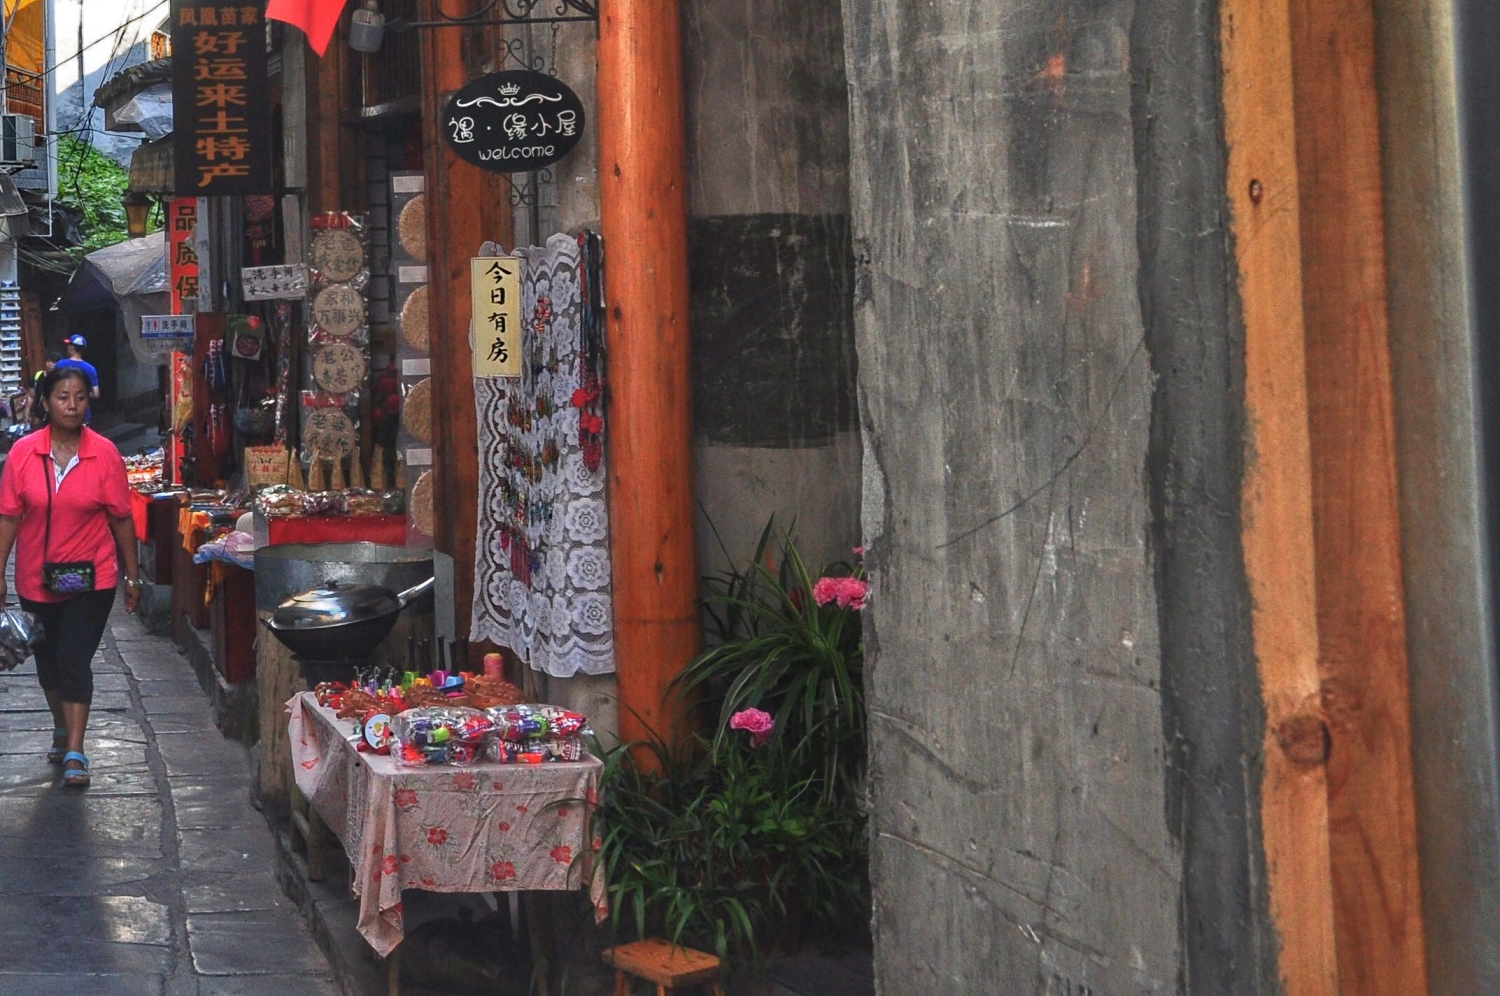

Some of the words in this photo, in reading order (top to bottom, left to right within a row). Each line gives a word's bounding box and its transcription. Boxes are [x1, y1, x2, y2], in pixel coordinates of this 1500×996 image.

[179, 6, 259, 27] 凤凰苗家
[193, 31, 251, 188] 好运来土特产
[478, 144, 555, 161] welcome
[252, 266, 293, 281] 洗手间
[484, 260, 513, 365] 今日有房
[161, 319, 188, 331] 洗手间
